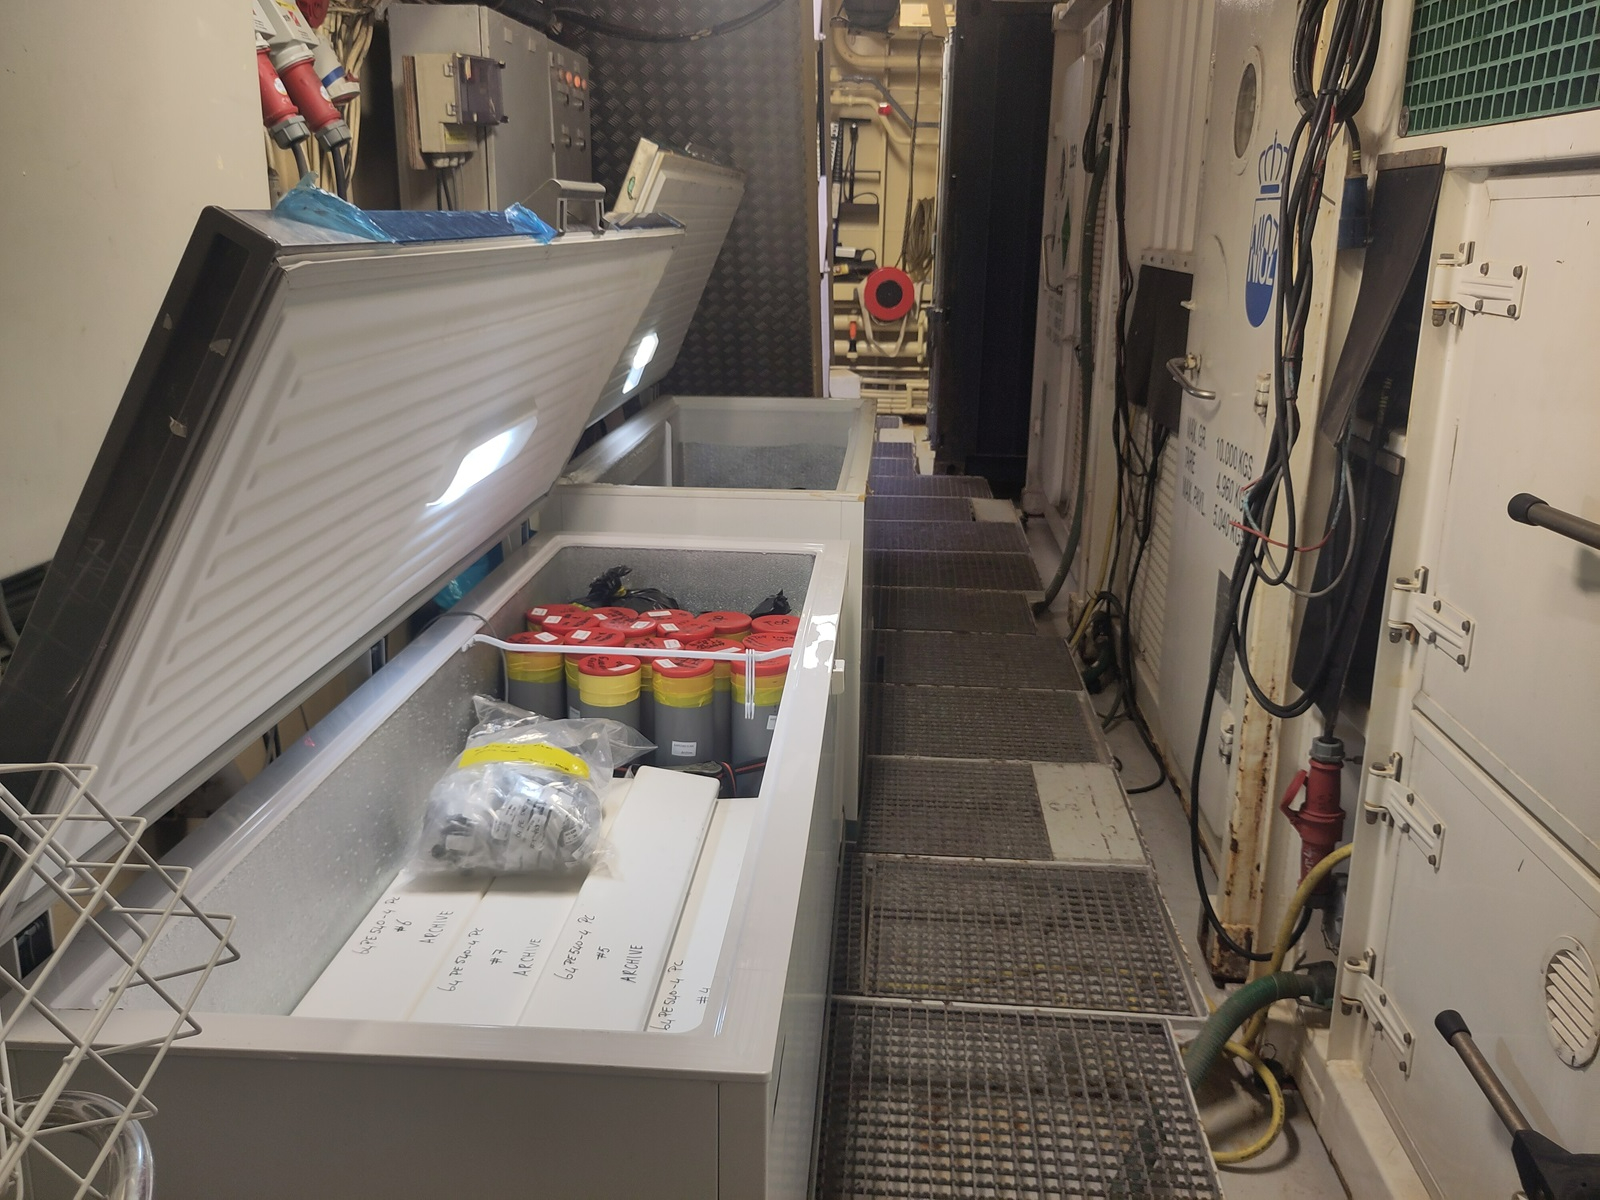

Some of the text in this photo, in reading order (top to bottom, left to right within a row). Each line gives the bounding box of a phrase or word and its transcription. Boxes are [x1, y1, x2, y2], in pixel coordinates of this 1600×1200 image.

[1246, 213, 1279, 286] NIOZ
[1184, 446, 1196, 474] TARE
[1216, 437, 1237, 470] 10.000
[1238, 448, 1254, 481] KGS
[395, 919, 412, 932] #6
[419, 911, 454, 943] ARCHIVE
[490, 948, 508, 965] #7
[512, 938, 542, 976] ARCHIVE
[596, 946, 610, 960] #5
[620, 944, 644, 983] ARCHIVE
[667, 960, 684, 972] PC
